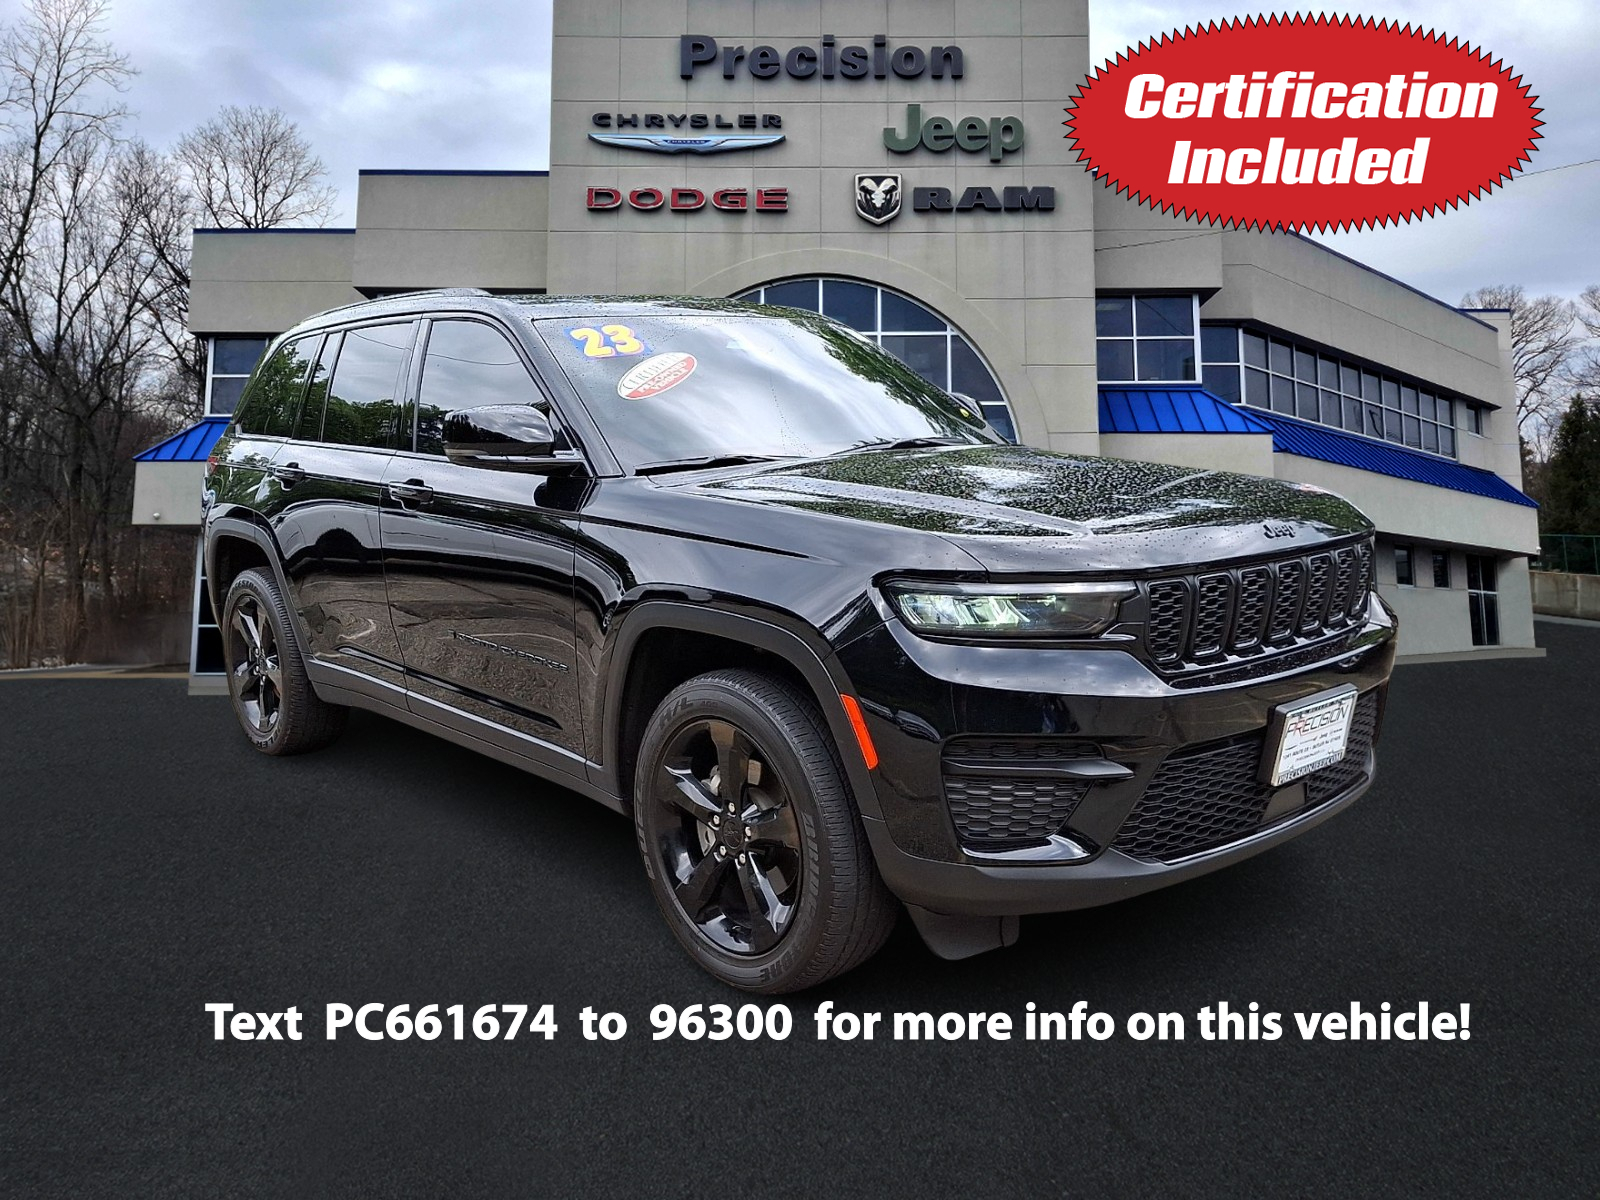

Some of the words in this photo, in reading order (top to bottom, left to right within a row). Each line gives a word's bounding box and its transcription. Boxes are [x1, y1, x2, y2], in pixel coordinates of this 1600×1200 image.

[680, 34, 964, 80] Precision
[592, 112, 782, 129] CHRYSLER
[883, 103, 1024, 163] Jeep
[586, 187, 788, 212] DODGE
[913, 186, 1055, 213] RAM
[570, 324, 645, 358] 23
[1263, 524, 1296, 539] Jeep
[1286, 705, 1348, 736] PRECISION
